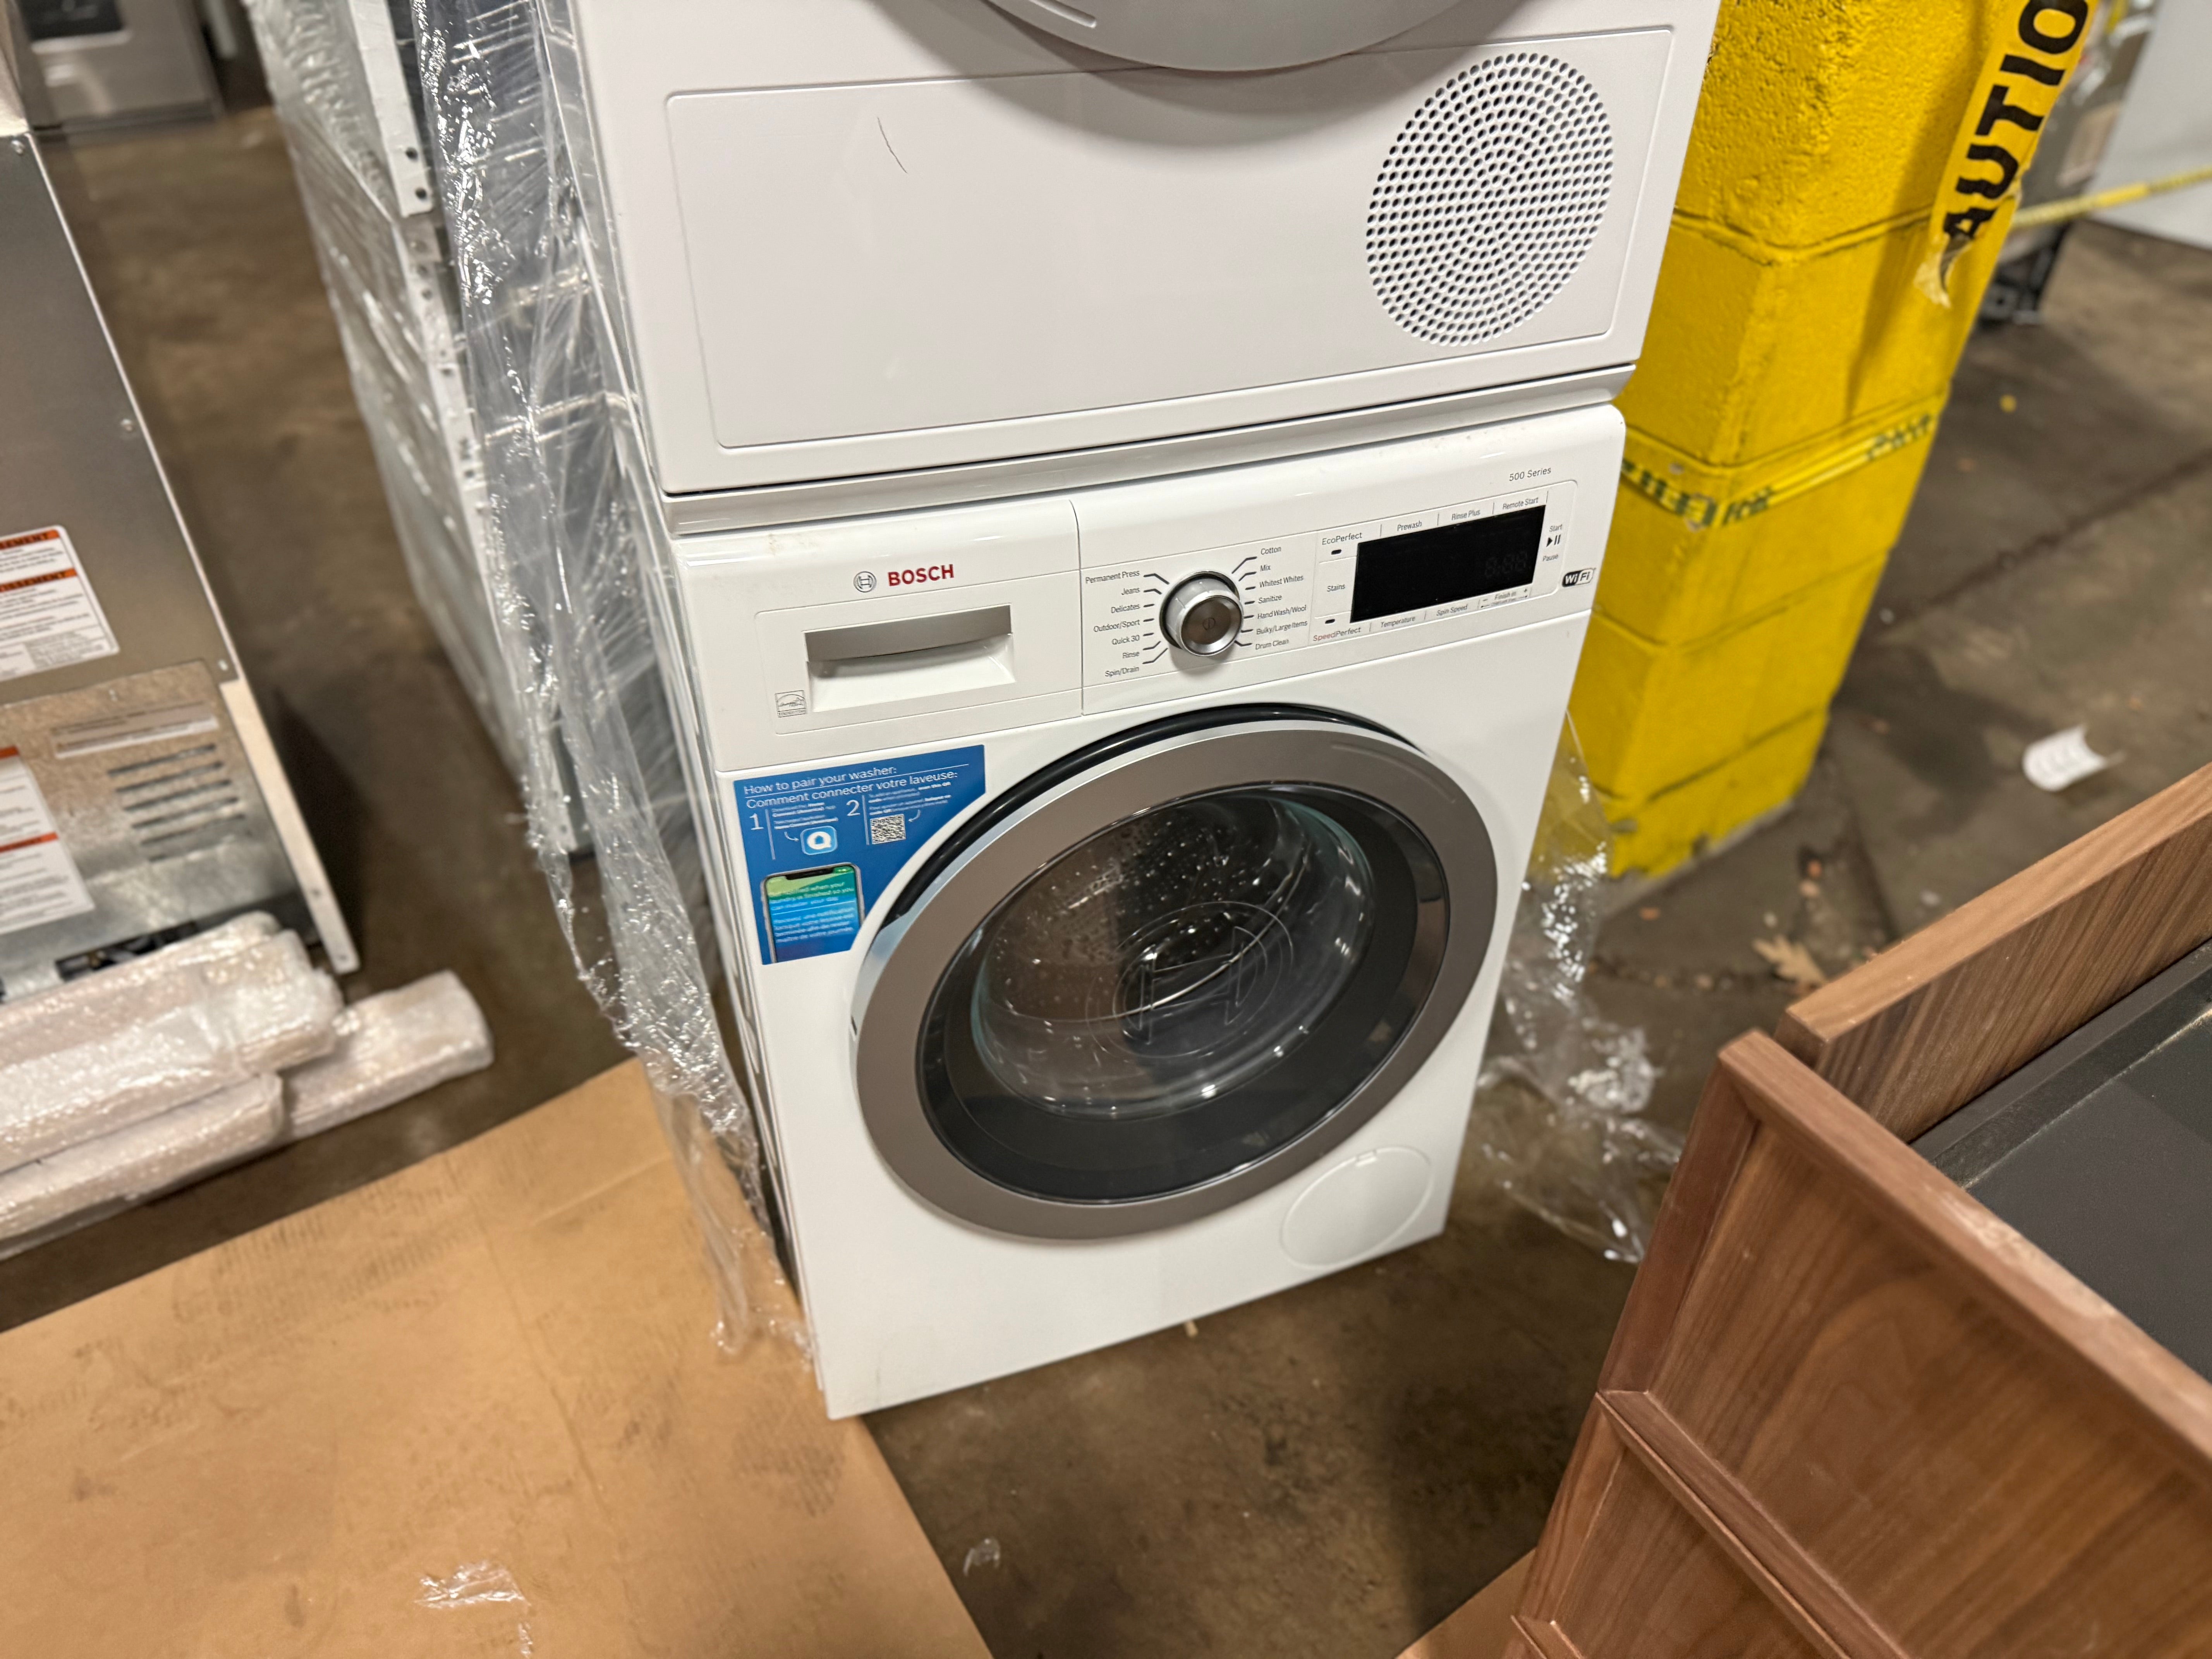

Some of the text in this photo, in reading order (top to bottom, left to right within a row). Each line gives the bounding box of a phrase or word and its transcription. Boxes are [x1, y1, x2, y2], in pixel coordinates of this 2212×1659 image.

[1509, 467, 1551, 481] 500 Series
[1503, 497, 1538, 510] Remote Start
[1451, 509, 1480, 520] Rinse Plus
[1397, 521, 1422, 531] Prewash
[1549, 524, 1562, 532] Start
[1322, 532, 1362, 544] EcoPerfect
[1261, 546, 1281, 555] Cotton
[888, 564, 955, 586] BOSCH
[1085, 570, 1140, 583] Permanent Press
[1259, 575, 1304, 587] Whitest Whites
[1121, 587, 1140, 595] Jeans
[1327, 583, 1345, 592] Stains
[1259, 595, 1281, 603] Sanitize
[1111, 603, 1140, 613] Delicates
[1257, 605, 1306, 619] Hand Wash/Wool
[1450, 604, 1468, 613] Speed
[1094, 620, 1140, 632] Outdoor/Sport
[1381, 616, 1415, 628] Temperature
[1256, 624, 1290, 635] Bulky/Large
[1313, 626, 1361, 641] SpeedPerfect
[1112, 636, 1130, 645] Quick
[1105, 666, 1139, 677] Spin/Drain
[744, 767, 896, 794] How to pair your washer:
[746, 793, 809, 809] Comment
[812, 784, 873, 800] connecter
[876, 779, 907, 790] votre
[910, 771, 958, 785] laveuse:
[846, 800, 860, 816] 2
[749, 813, 764, 830] 1
